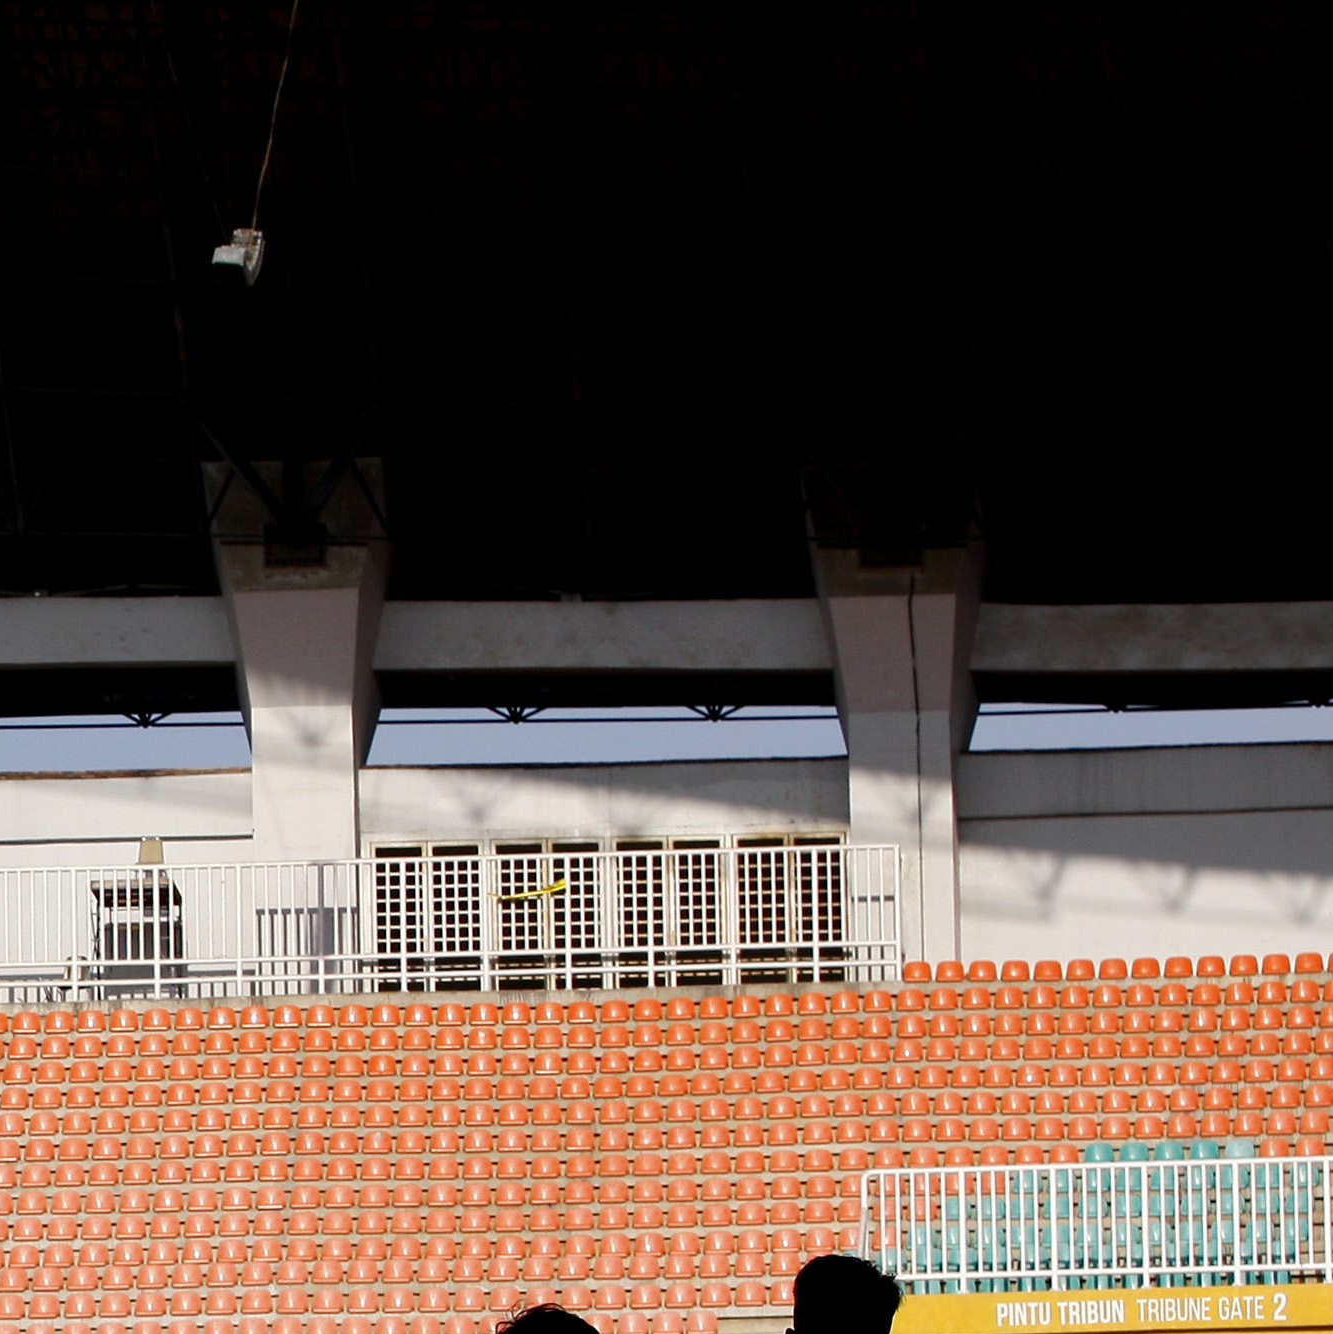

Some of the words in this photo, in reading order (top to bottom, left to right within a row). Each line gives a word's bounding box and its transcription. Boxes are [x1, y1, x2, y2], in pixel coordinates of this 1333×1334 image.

[996, 1302, 1051, 1327] PINTU
[1057, 1300, 1125, 1325] TRIBUN
[1136, 1297, 1212, 1322] TRIBUNE
[1218, 1296, 1265, 1321] GATE
[1273, 1293, 1288, 1321] 2
